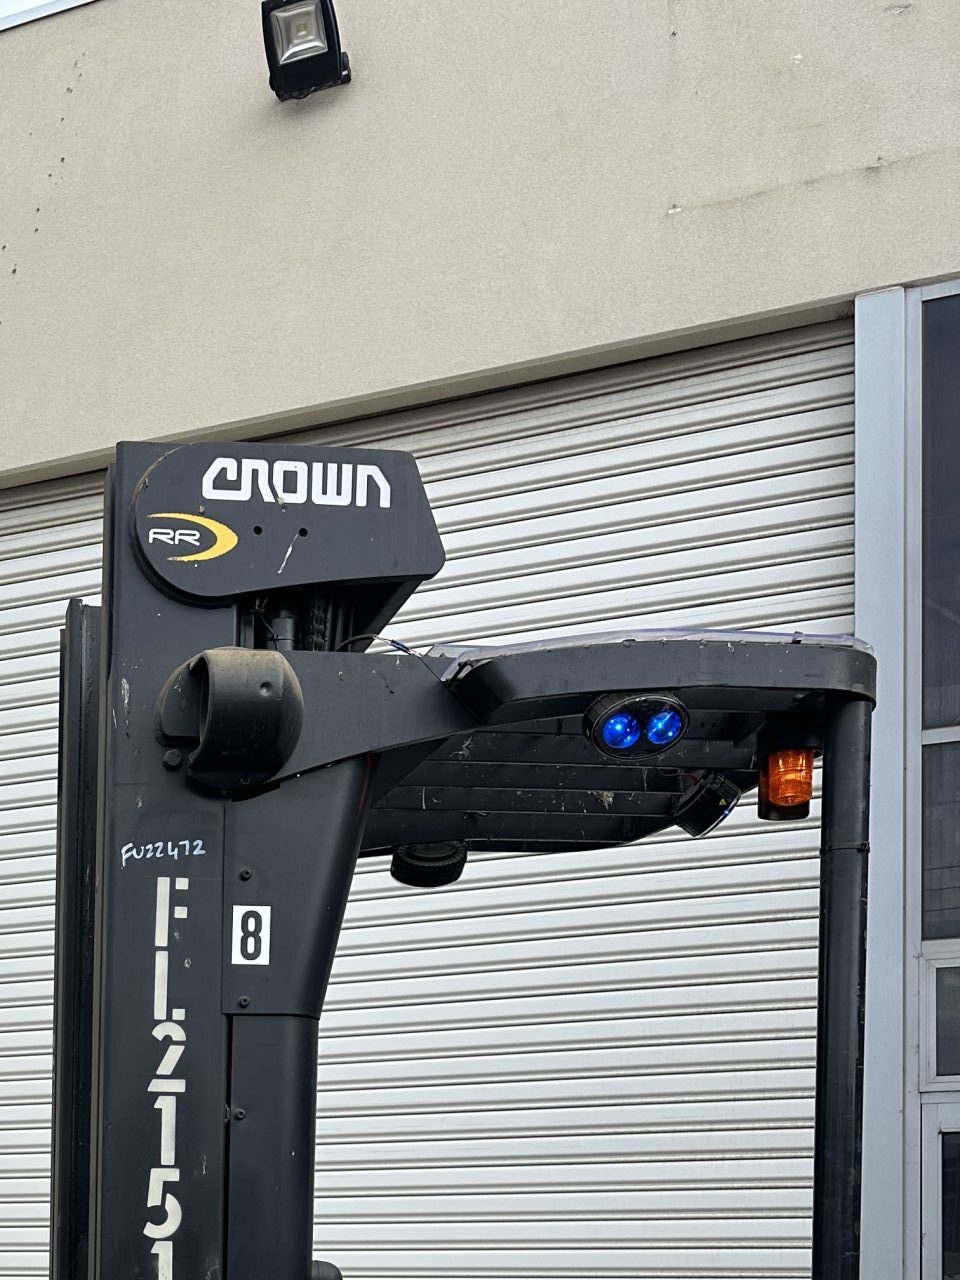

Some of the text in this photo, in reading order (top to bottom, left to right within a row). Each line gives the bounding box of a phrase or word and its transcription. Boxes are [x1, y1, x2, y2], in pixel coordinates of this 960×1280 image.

[202, 457, 391, 508] CROWN
[148, 527, 201, 546] RR
[121, 839, 206, 867] FU22472
[240, 910, 262, 961] 8
